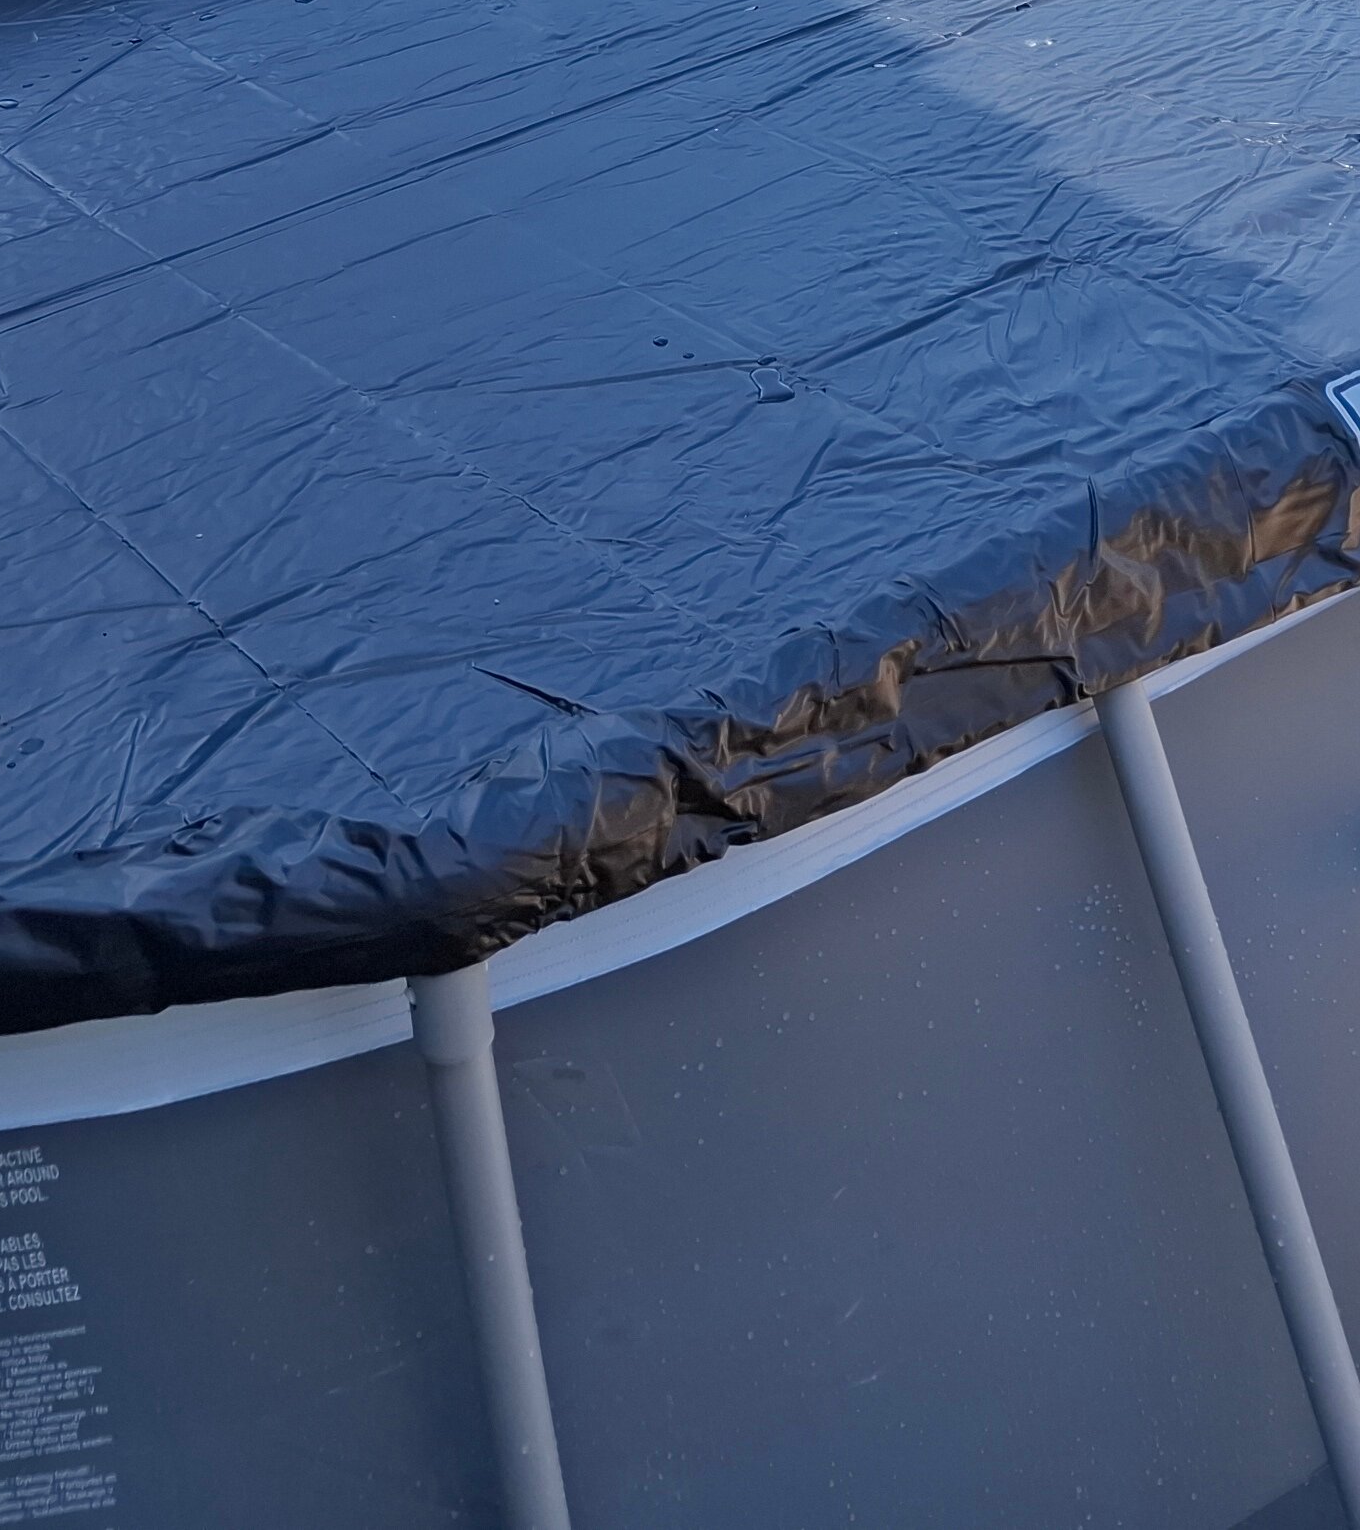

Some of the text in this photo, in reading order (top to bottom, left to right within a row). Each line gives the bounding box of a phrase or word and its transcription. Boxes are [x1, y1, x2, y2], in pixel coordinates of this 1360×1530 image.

[5, 1163, 60, 1186] AROUND
[22, 1252, 46, 1269] LES
[18, 1268, 69, 1289] PORTER
[8, 1285, 82, 1311] CONSULTEZ
